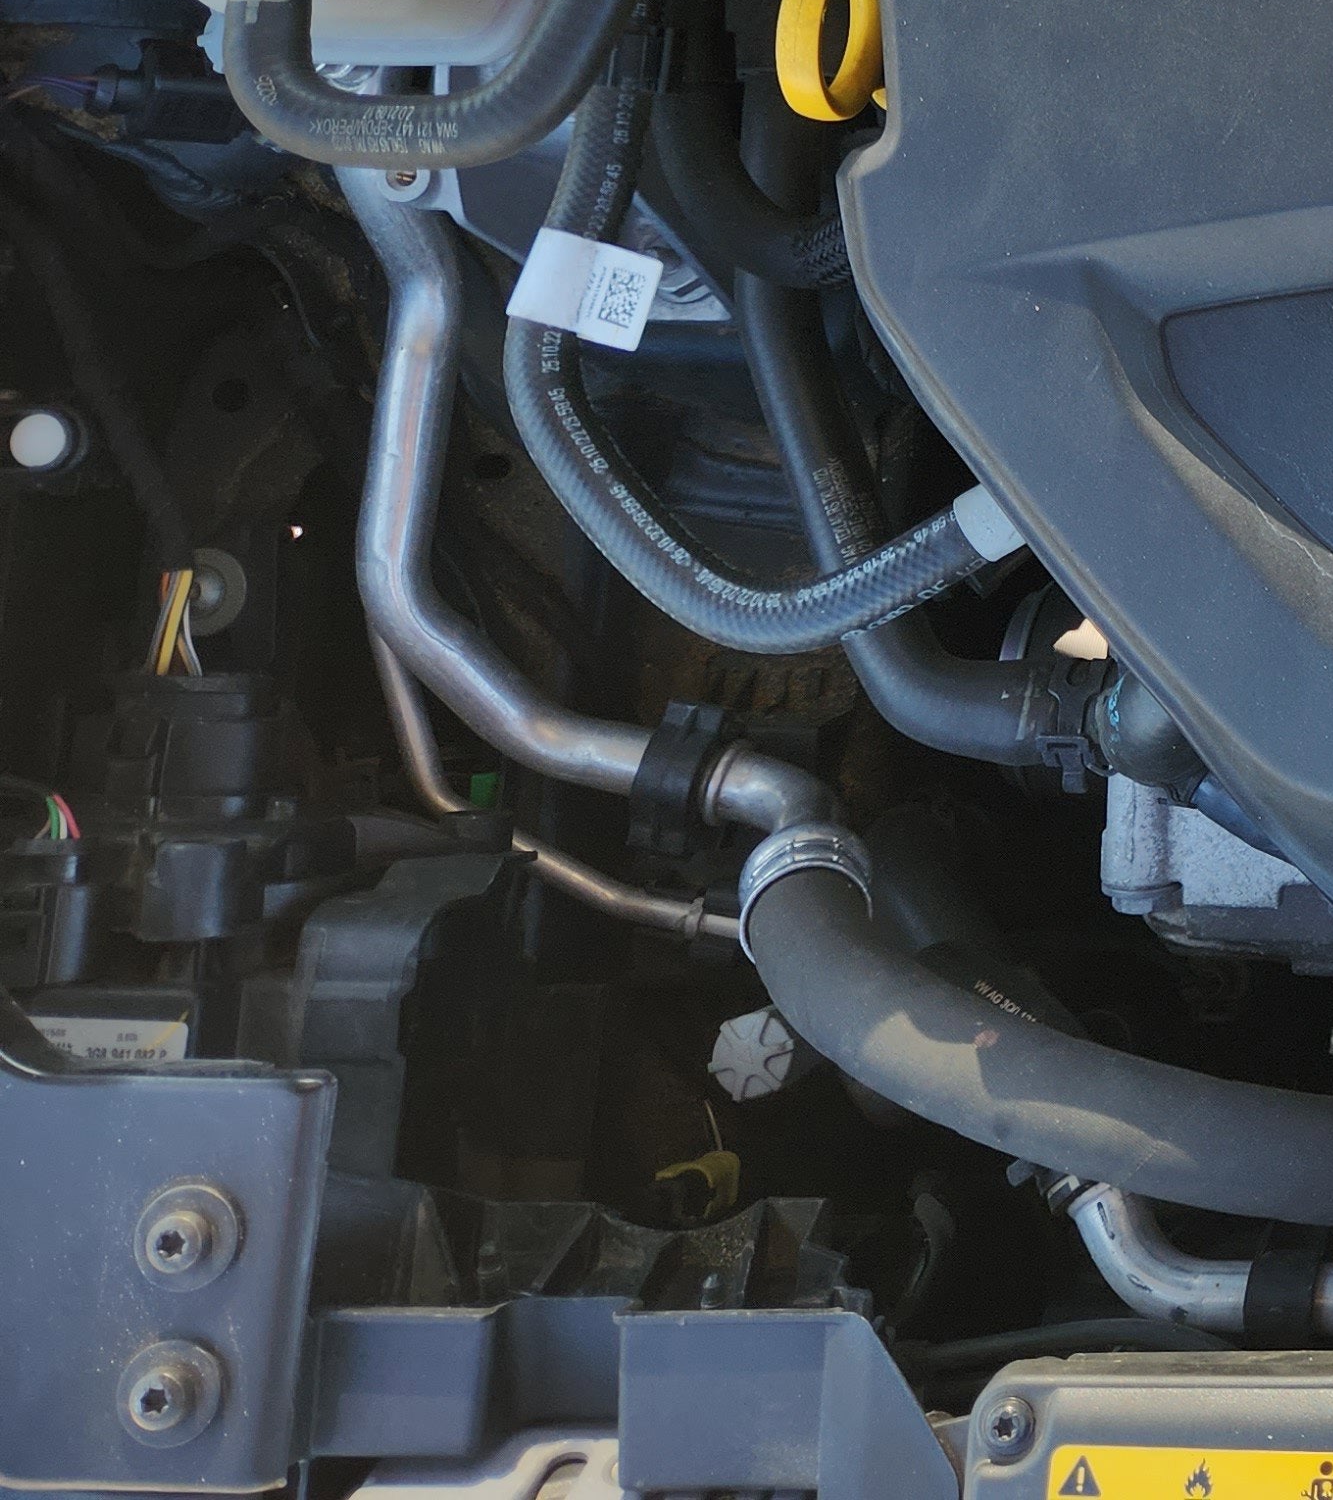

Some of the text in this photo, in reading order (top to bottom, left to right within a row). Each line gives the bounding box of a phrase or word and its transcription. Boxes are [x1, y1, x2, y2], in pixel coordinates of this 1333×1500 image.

[397, 122, 414, 137] 447
[417, 122, 432, 137] 121
[435, 121, 458, 137] 5WA
